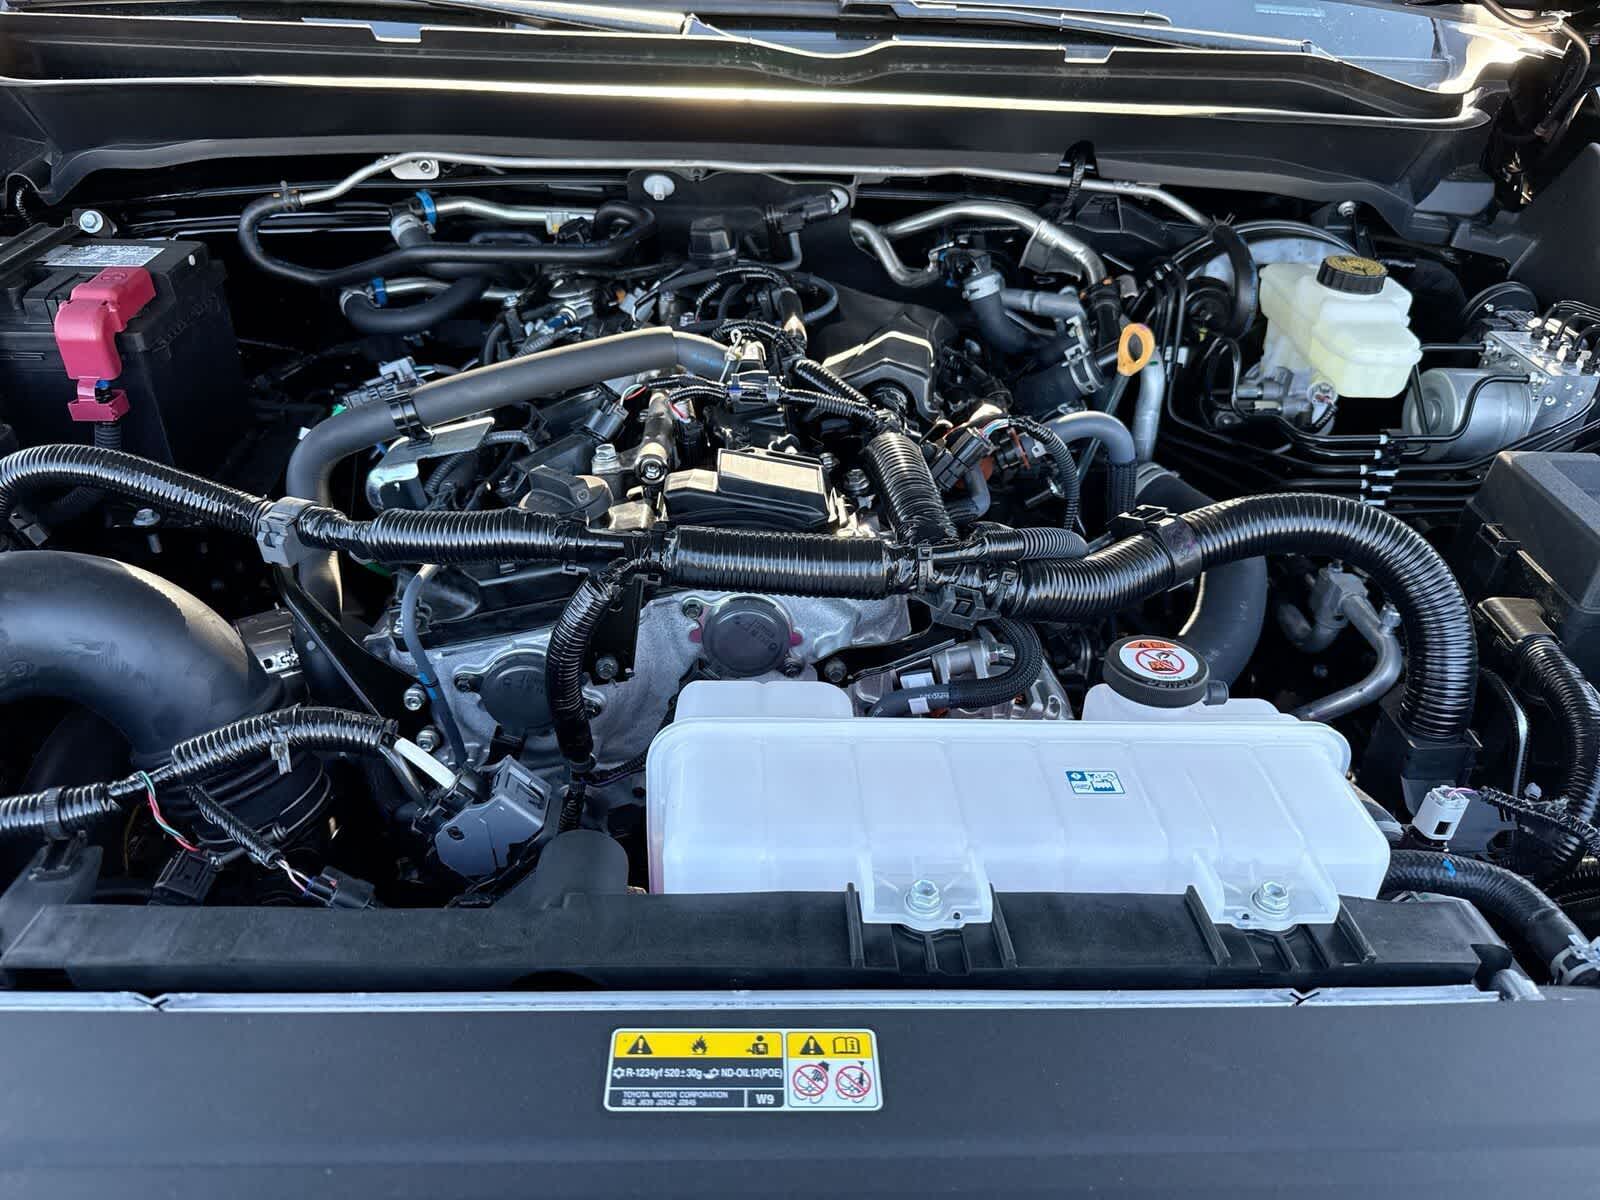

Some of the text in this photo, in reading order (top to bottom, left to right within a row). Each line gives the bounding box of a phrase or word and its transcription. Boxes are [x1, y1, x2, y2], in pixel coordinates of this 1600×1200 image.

[626, 1067, 663, 1079] R-1234yf
[721, 1067, 782, 1079] ND-OIL12(POE)
[755, 1094, 775, 1104] W9
